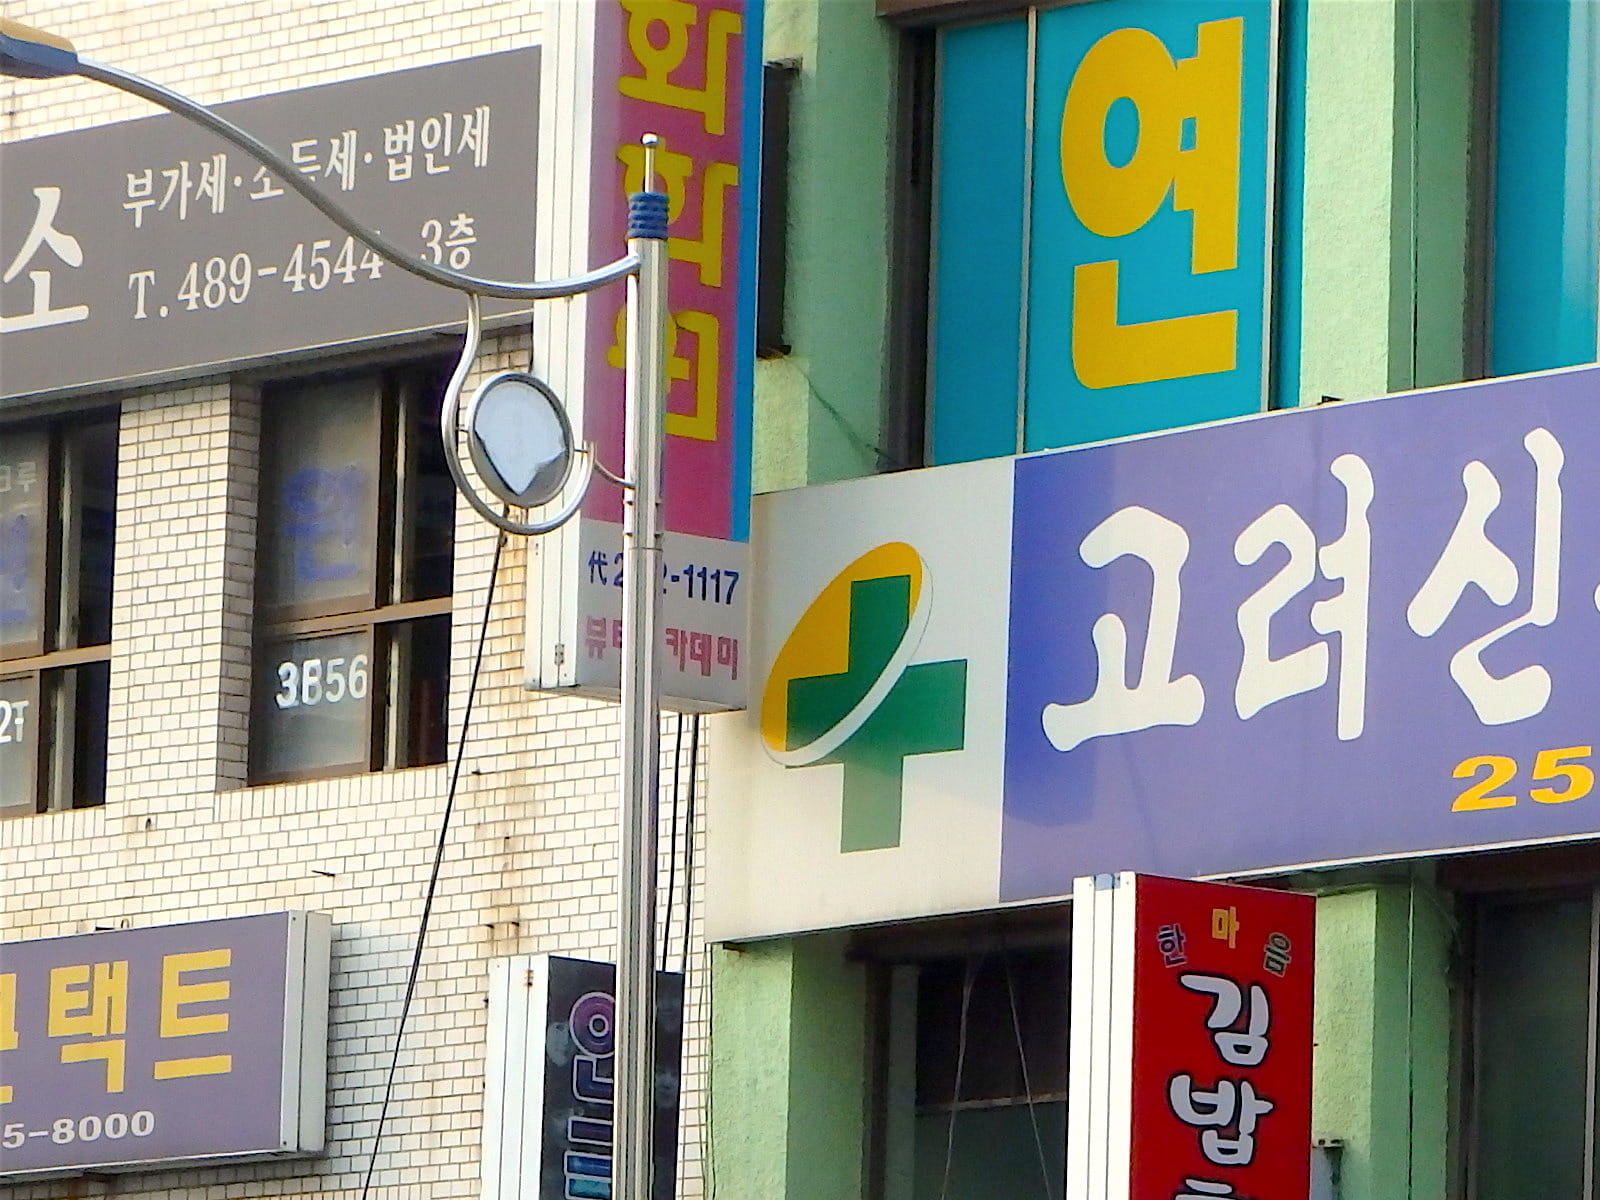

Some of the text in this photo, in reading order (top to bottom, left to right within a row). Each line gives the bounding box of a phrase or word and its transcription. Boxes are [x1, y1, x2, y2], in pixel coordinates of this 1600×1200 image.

[0, 187, 89, 333] 소
[420, 212, 478, 270] 3층
[664, 627, 739, 681] 카데미
[1155, 905, 1293, 978] 한마음
[2, 1110, 155, 1149] 5-8000
